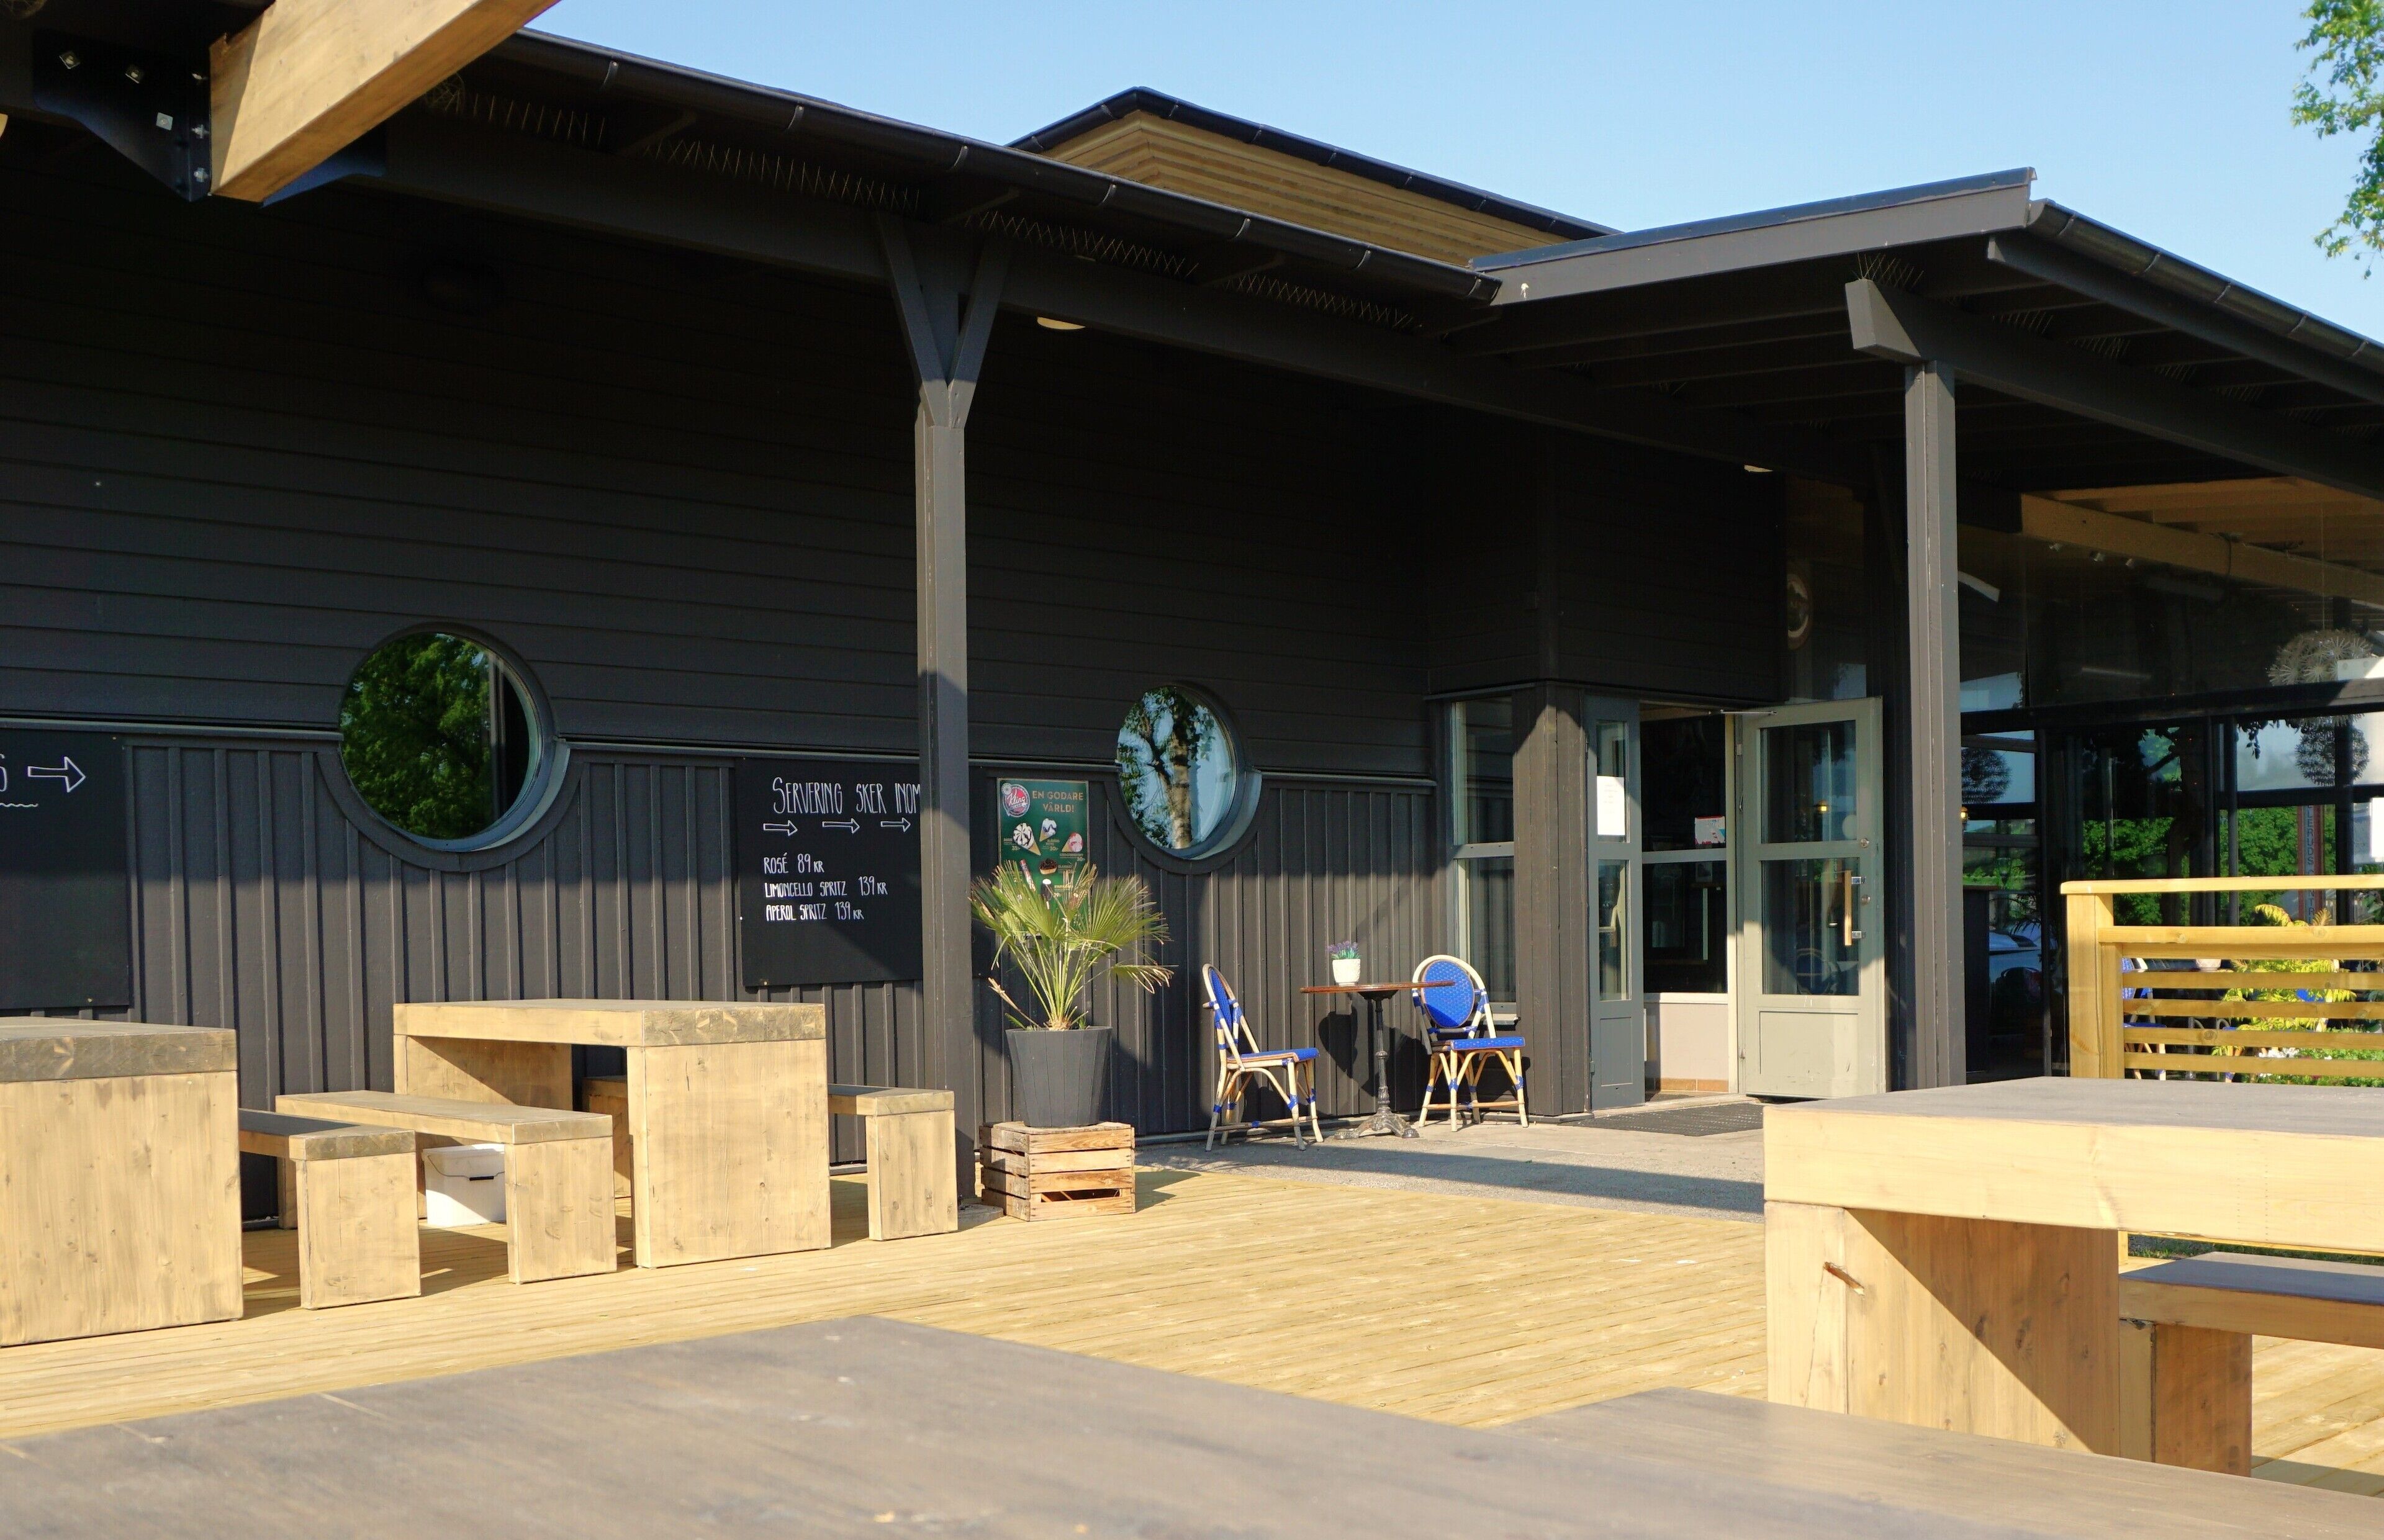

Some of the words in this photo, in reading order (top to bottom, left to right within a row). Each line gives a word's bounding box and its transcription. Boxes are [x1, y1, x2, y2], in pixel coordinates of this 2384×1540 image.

[772, 777, 843, 814] SERVERING
[856, 783, 887, 814] SKER
[1032, 790, 1044, 799] EN
[1047, 791, 1083, 800] GODARE
[764, 852, 788, 874] ROSÉ
[797, 853, 811, 873] 89
[813, 860, 824, 873] KR
[764, 882, 813, 898] LIMONCELLO
[820, 881, 847, 896] SPRITZ
[858, 875, 875, 896] 139
[877, 882, 888, 894] KR
[765, 904, 797, 921] APEROL
[799, 903, 827, 920] SPRITZ
[834, 901, 851, 920] 139
[853, 909, 864, 920] KR
